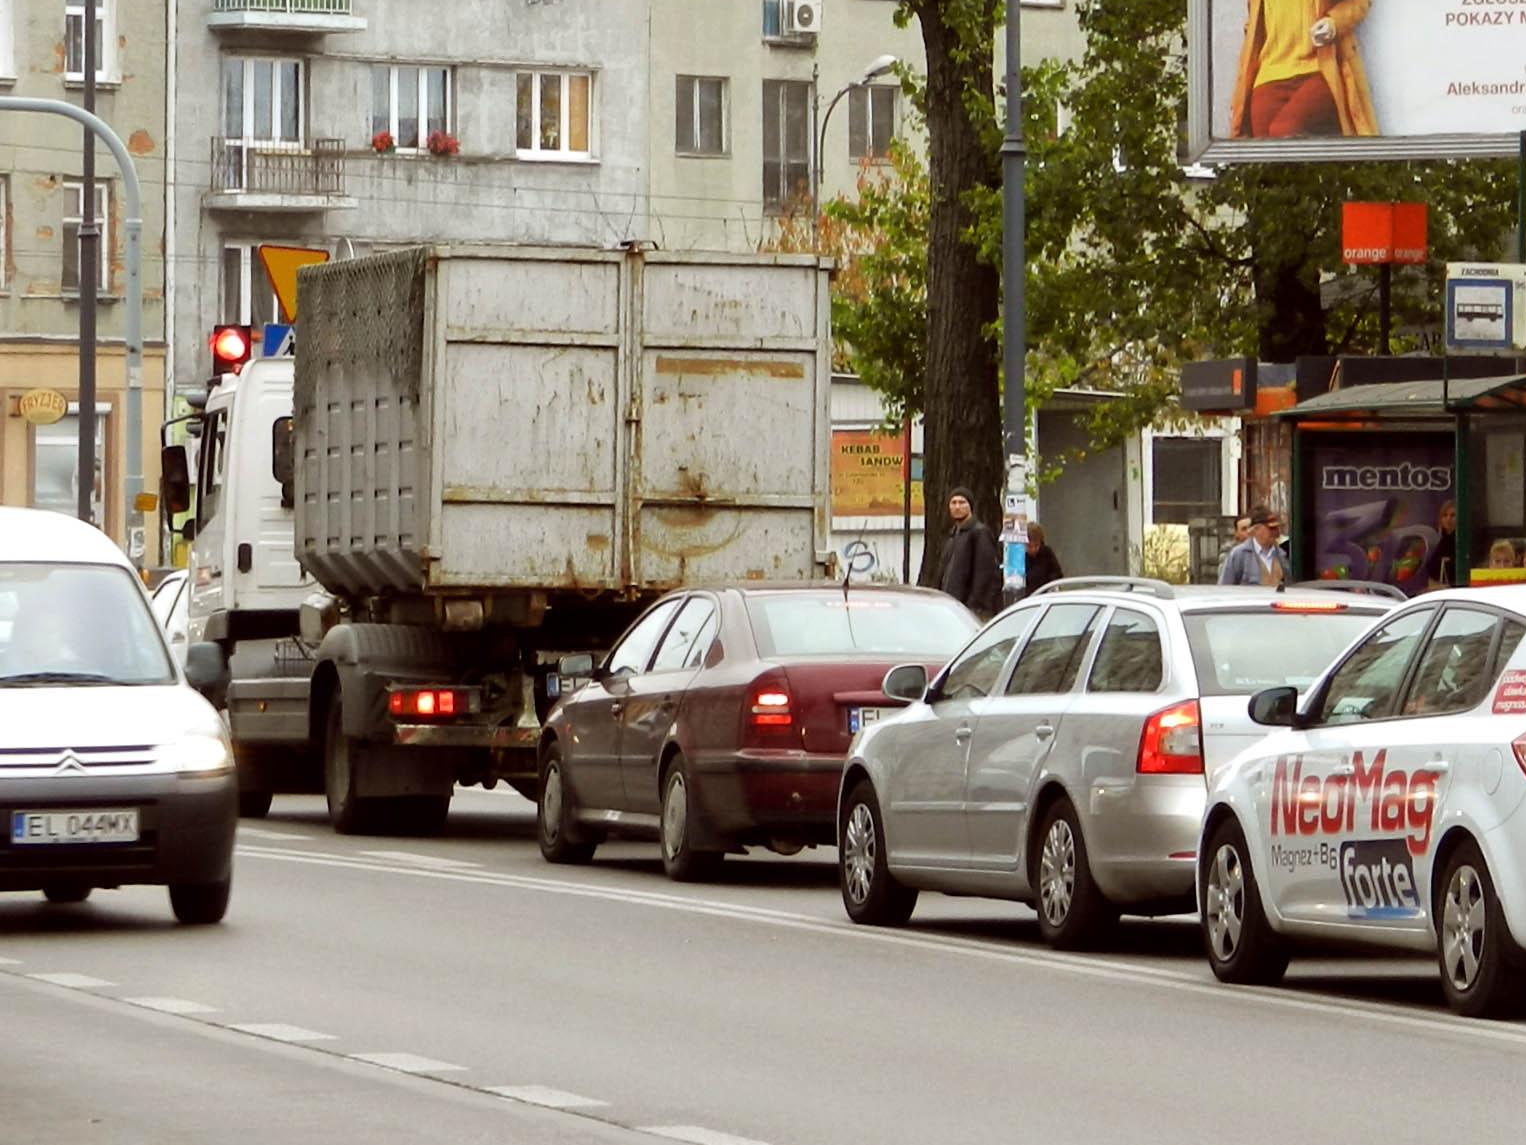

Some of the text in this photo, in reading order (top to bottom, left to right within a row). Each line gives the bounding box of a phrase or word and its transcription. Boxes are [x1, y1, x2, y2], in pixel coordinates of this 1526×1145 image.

[1445, 11, 1514, 27] POKAZY
[1344, 248, 1387, 261] orange
[841, 445, 880, 455] KEBAB
[1323, 463, 1451, 490] mentos
[1270, 748, 1441, 856] NeoMag
[29, 816, 59, 837] EL
[1343, 847, 1415, 911] forte
